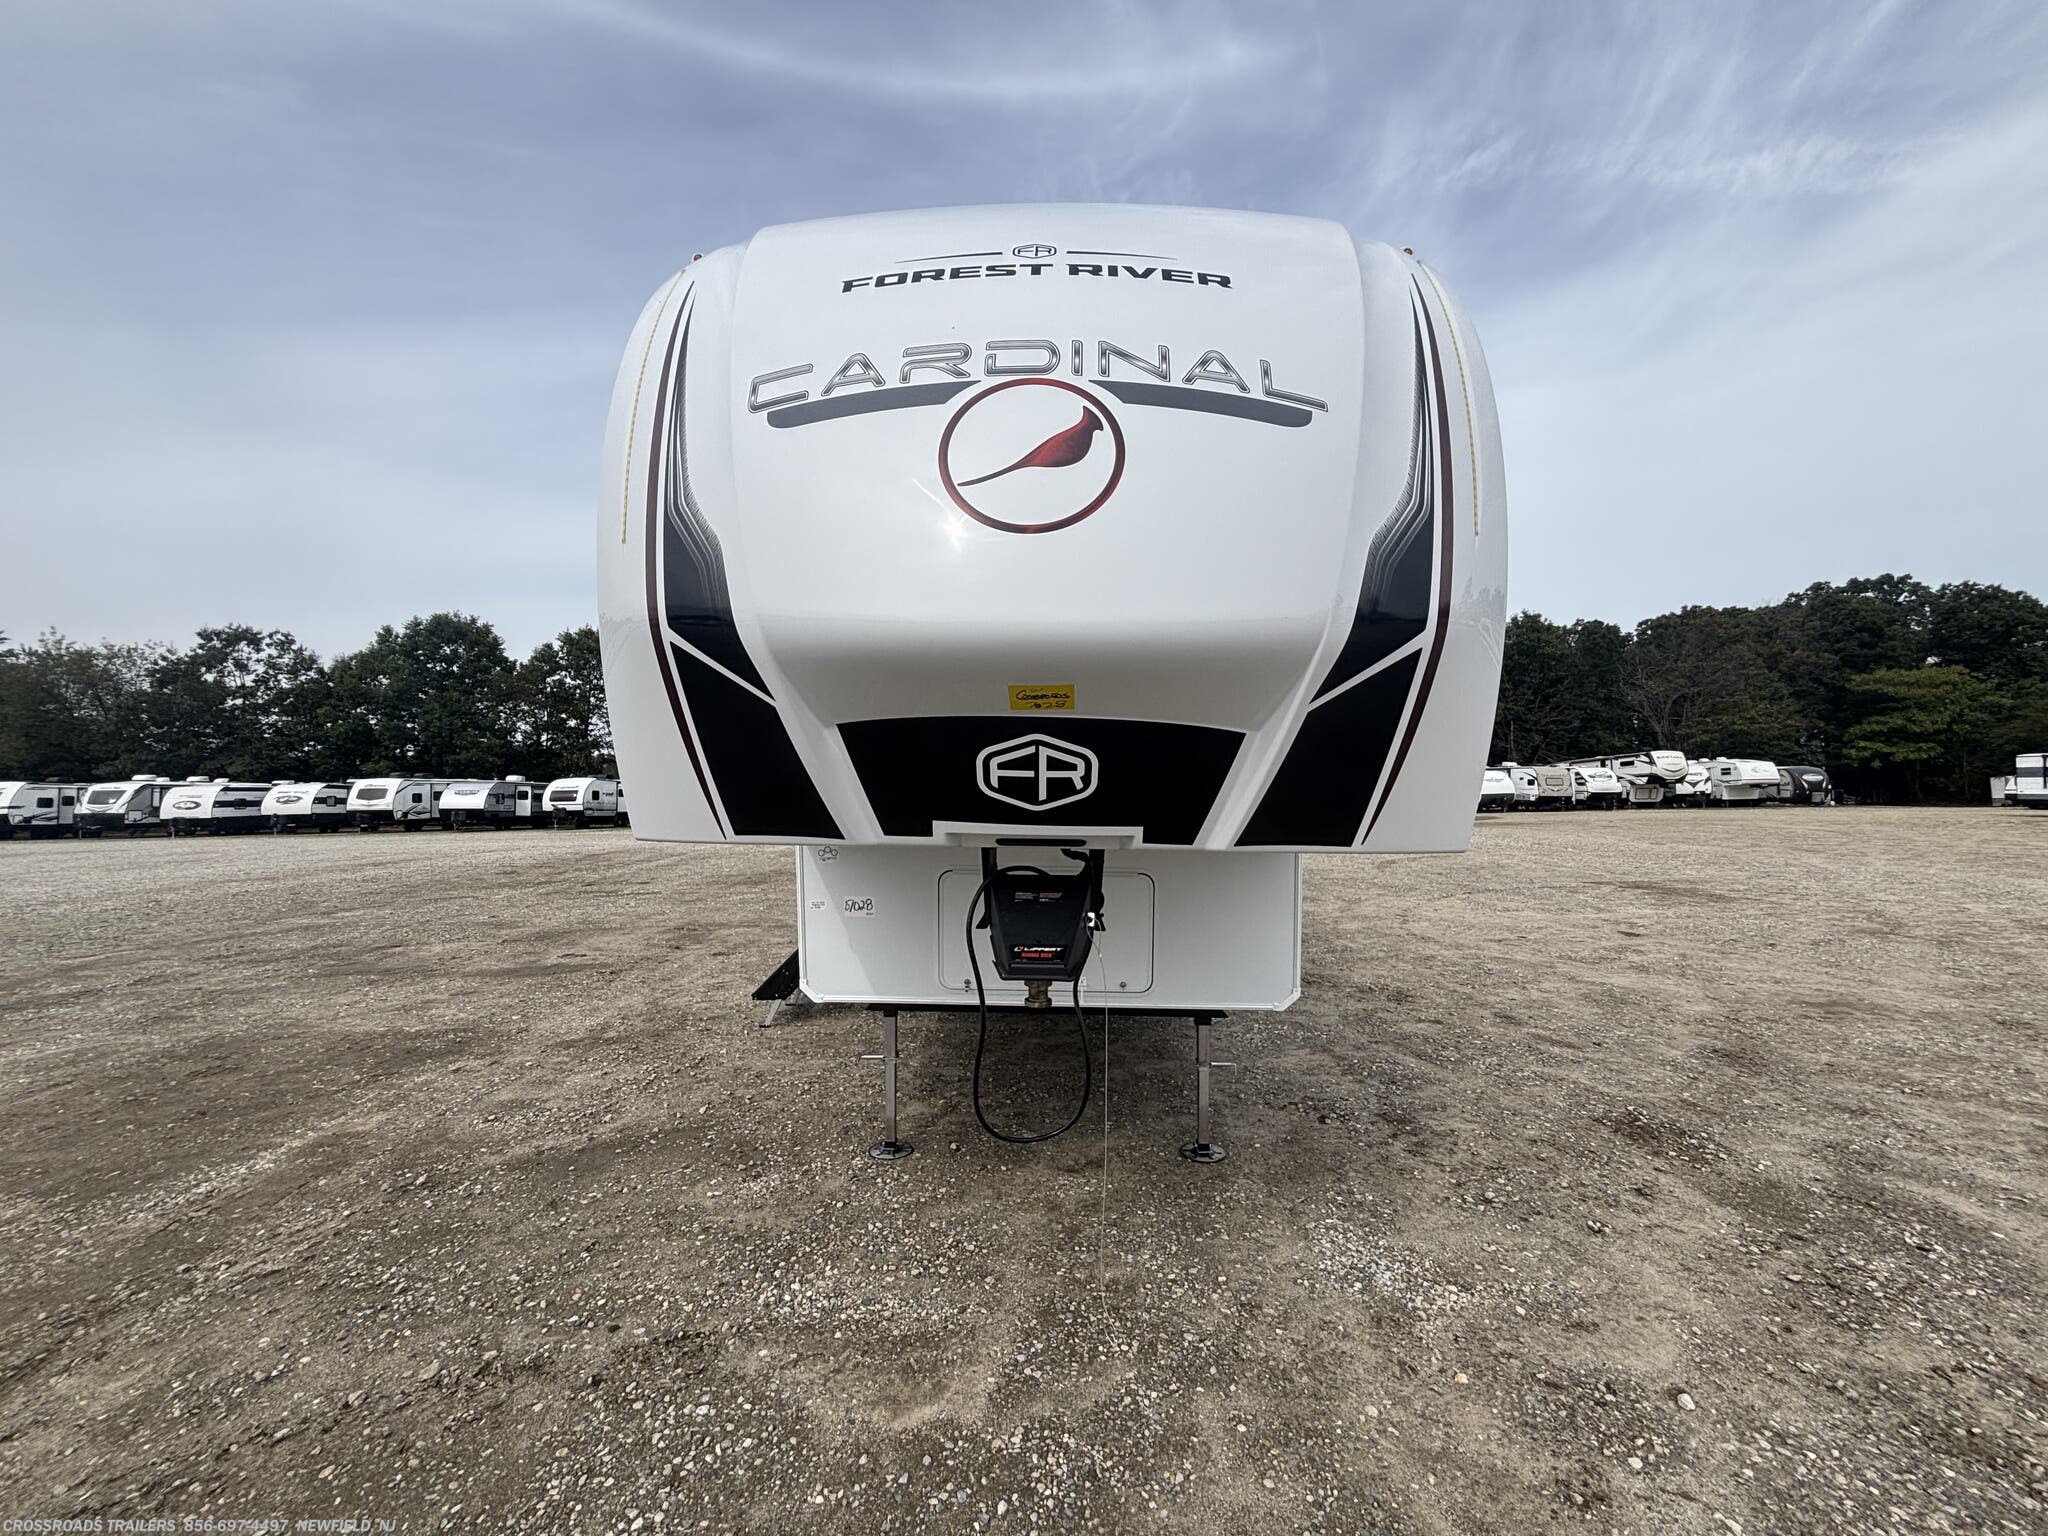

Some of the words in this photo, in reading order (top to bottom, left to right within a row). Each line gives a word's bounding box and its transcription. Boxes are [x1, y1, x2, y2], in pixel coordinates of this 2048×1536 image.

[841, 263, 1053, 293] FOREST
[1066, 263, 1233, 289] RIVER
[747, 339, 1329, 413] CARDINAL
